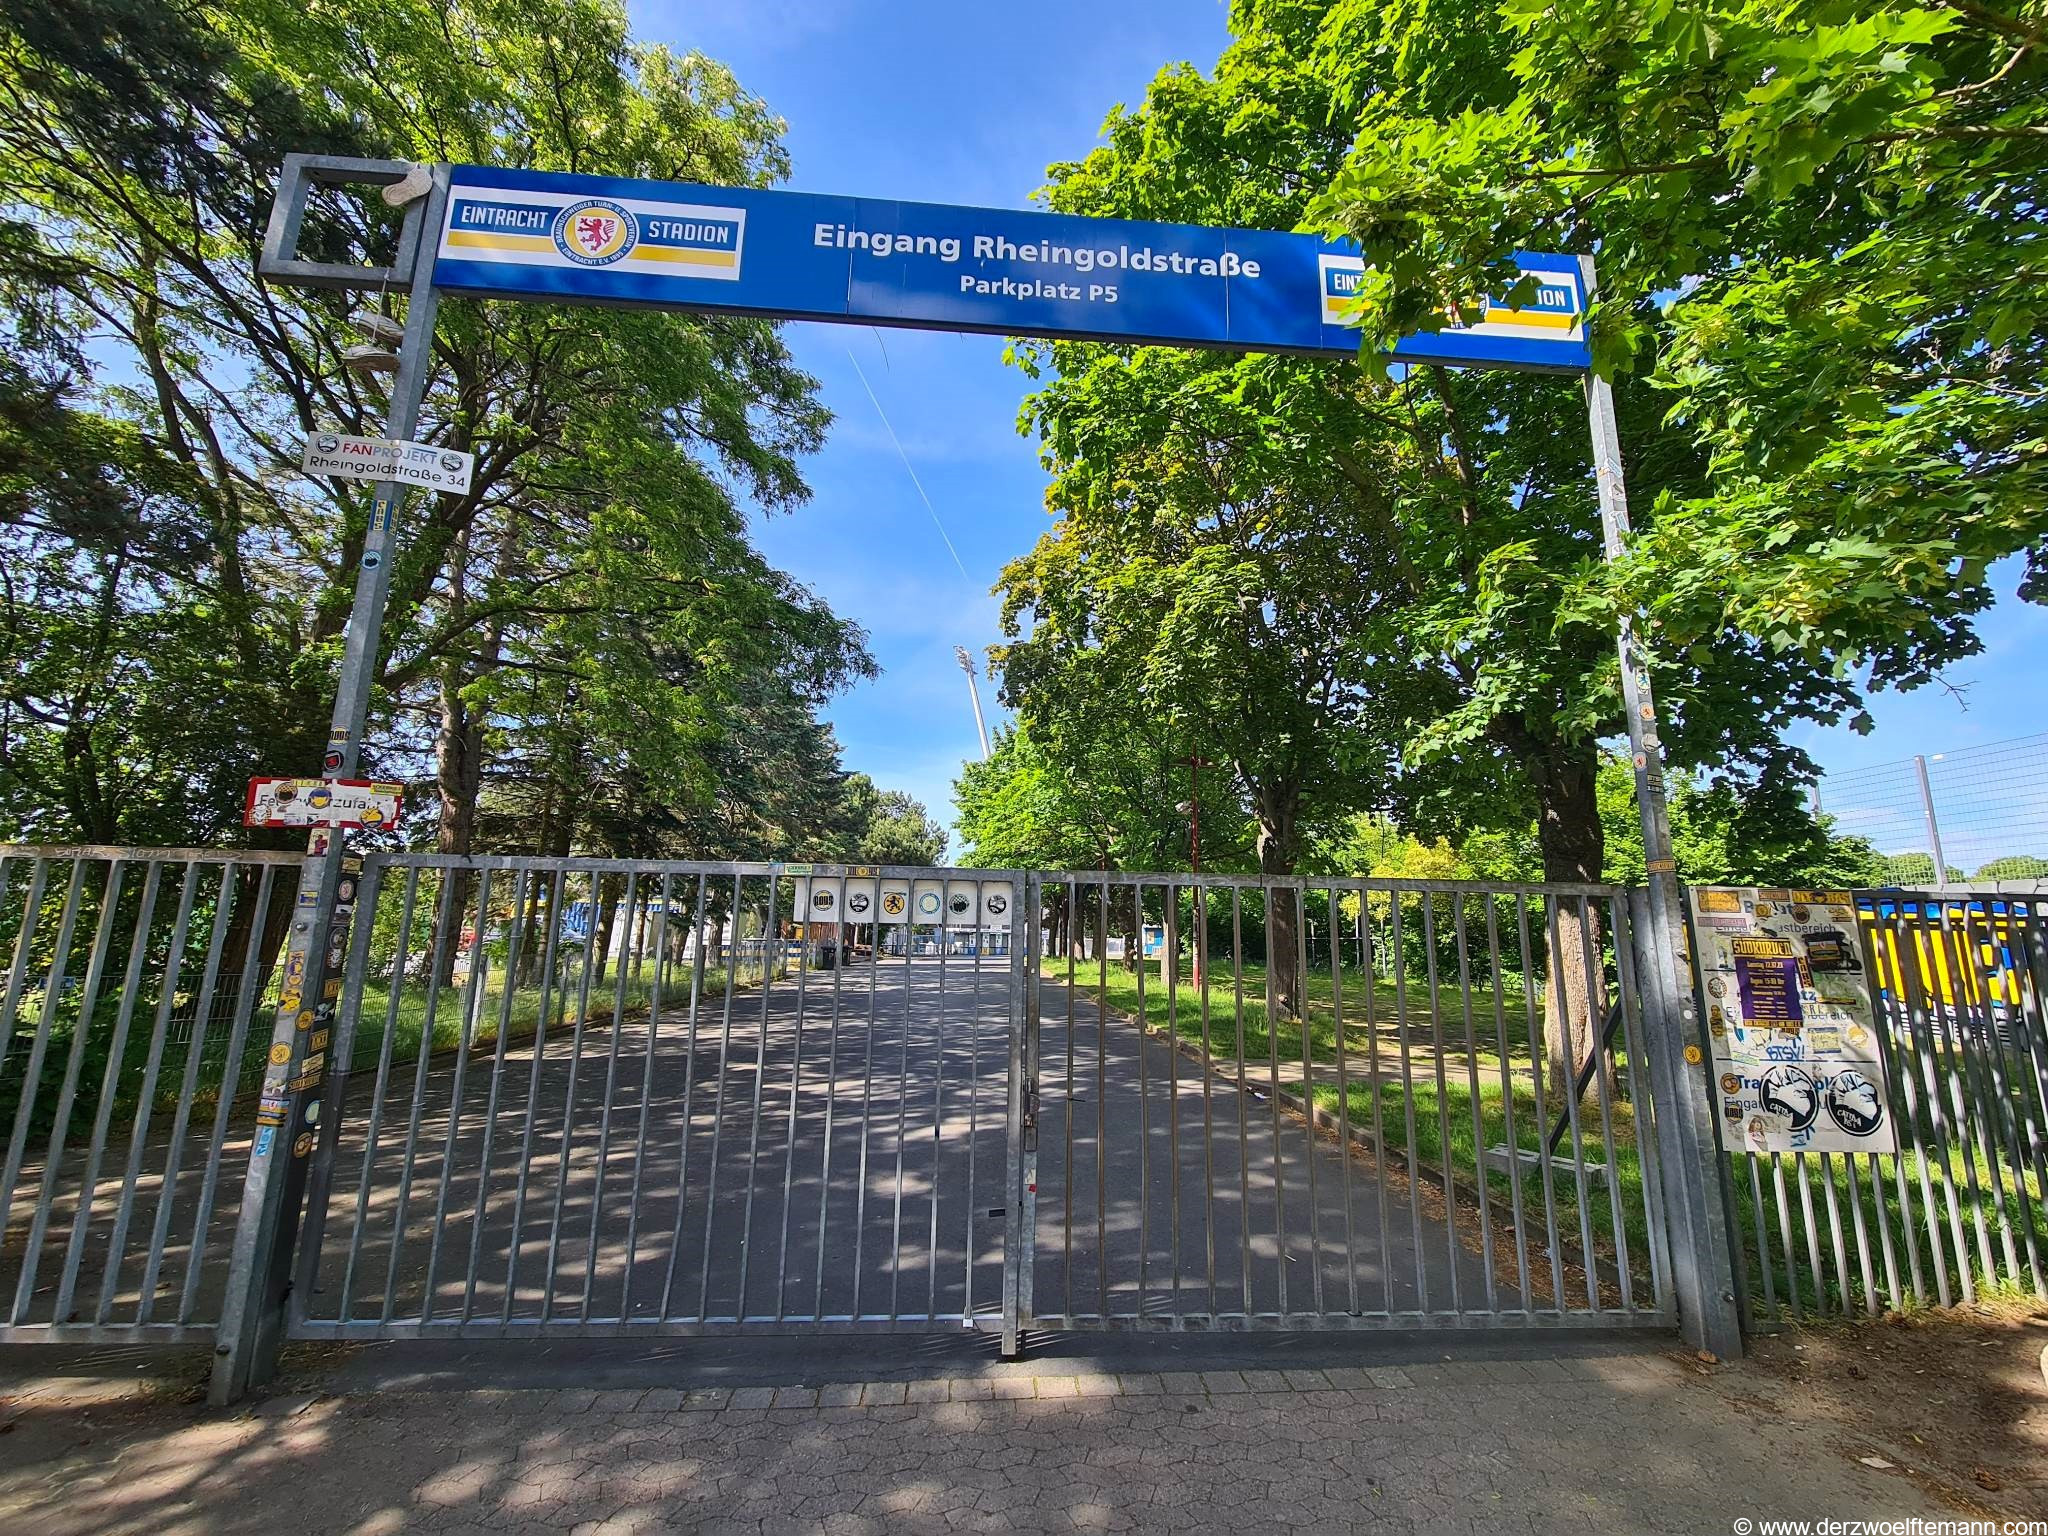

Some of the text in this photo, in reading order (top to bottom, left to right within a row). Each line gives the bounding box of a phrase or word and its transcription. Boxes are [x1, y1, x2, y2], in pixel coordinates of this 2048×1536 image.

[461, 205, 549, 230] EINTRACHT
[649, 221, 729, 244] STADION
[561, 247, 596, 265] EINTRACHT
[813, 223, 1261, 278] Eingang Rheingoldstraße
[960, 275, 1119, 303] Parkplatz P5
[343, 443, 437, 465] FANPROJEKT
[310, 456, 465, 488] Rheingoldstraße 34
